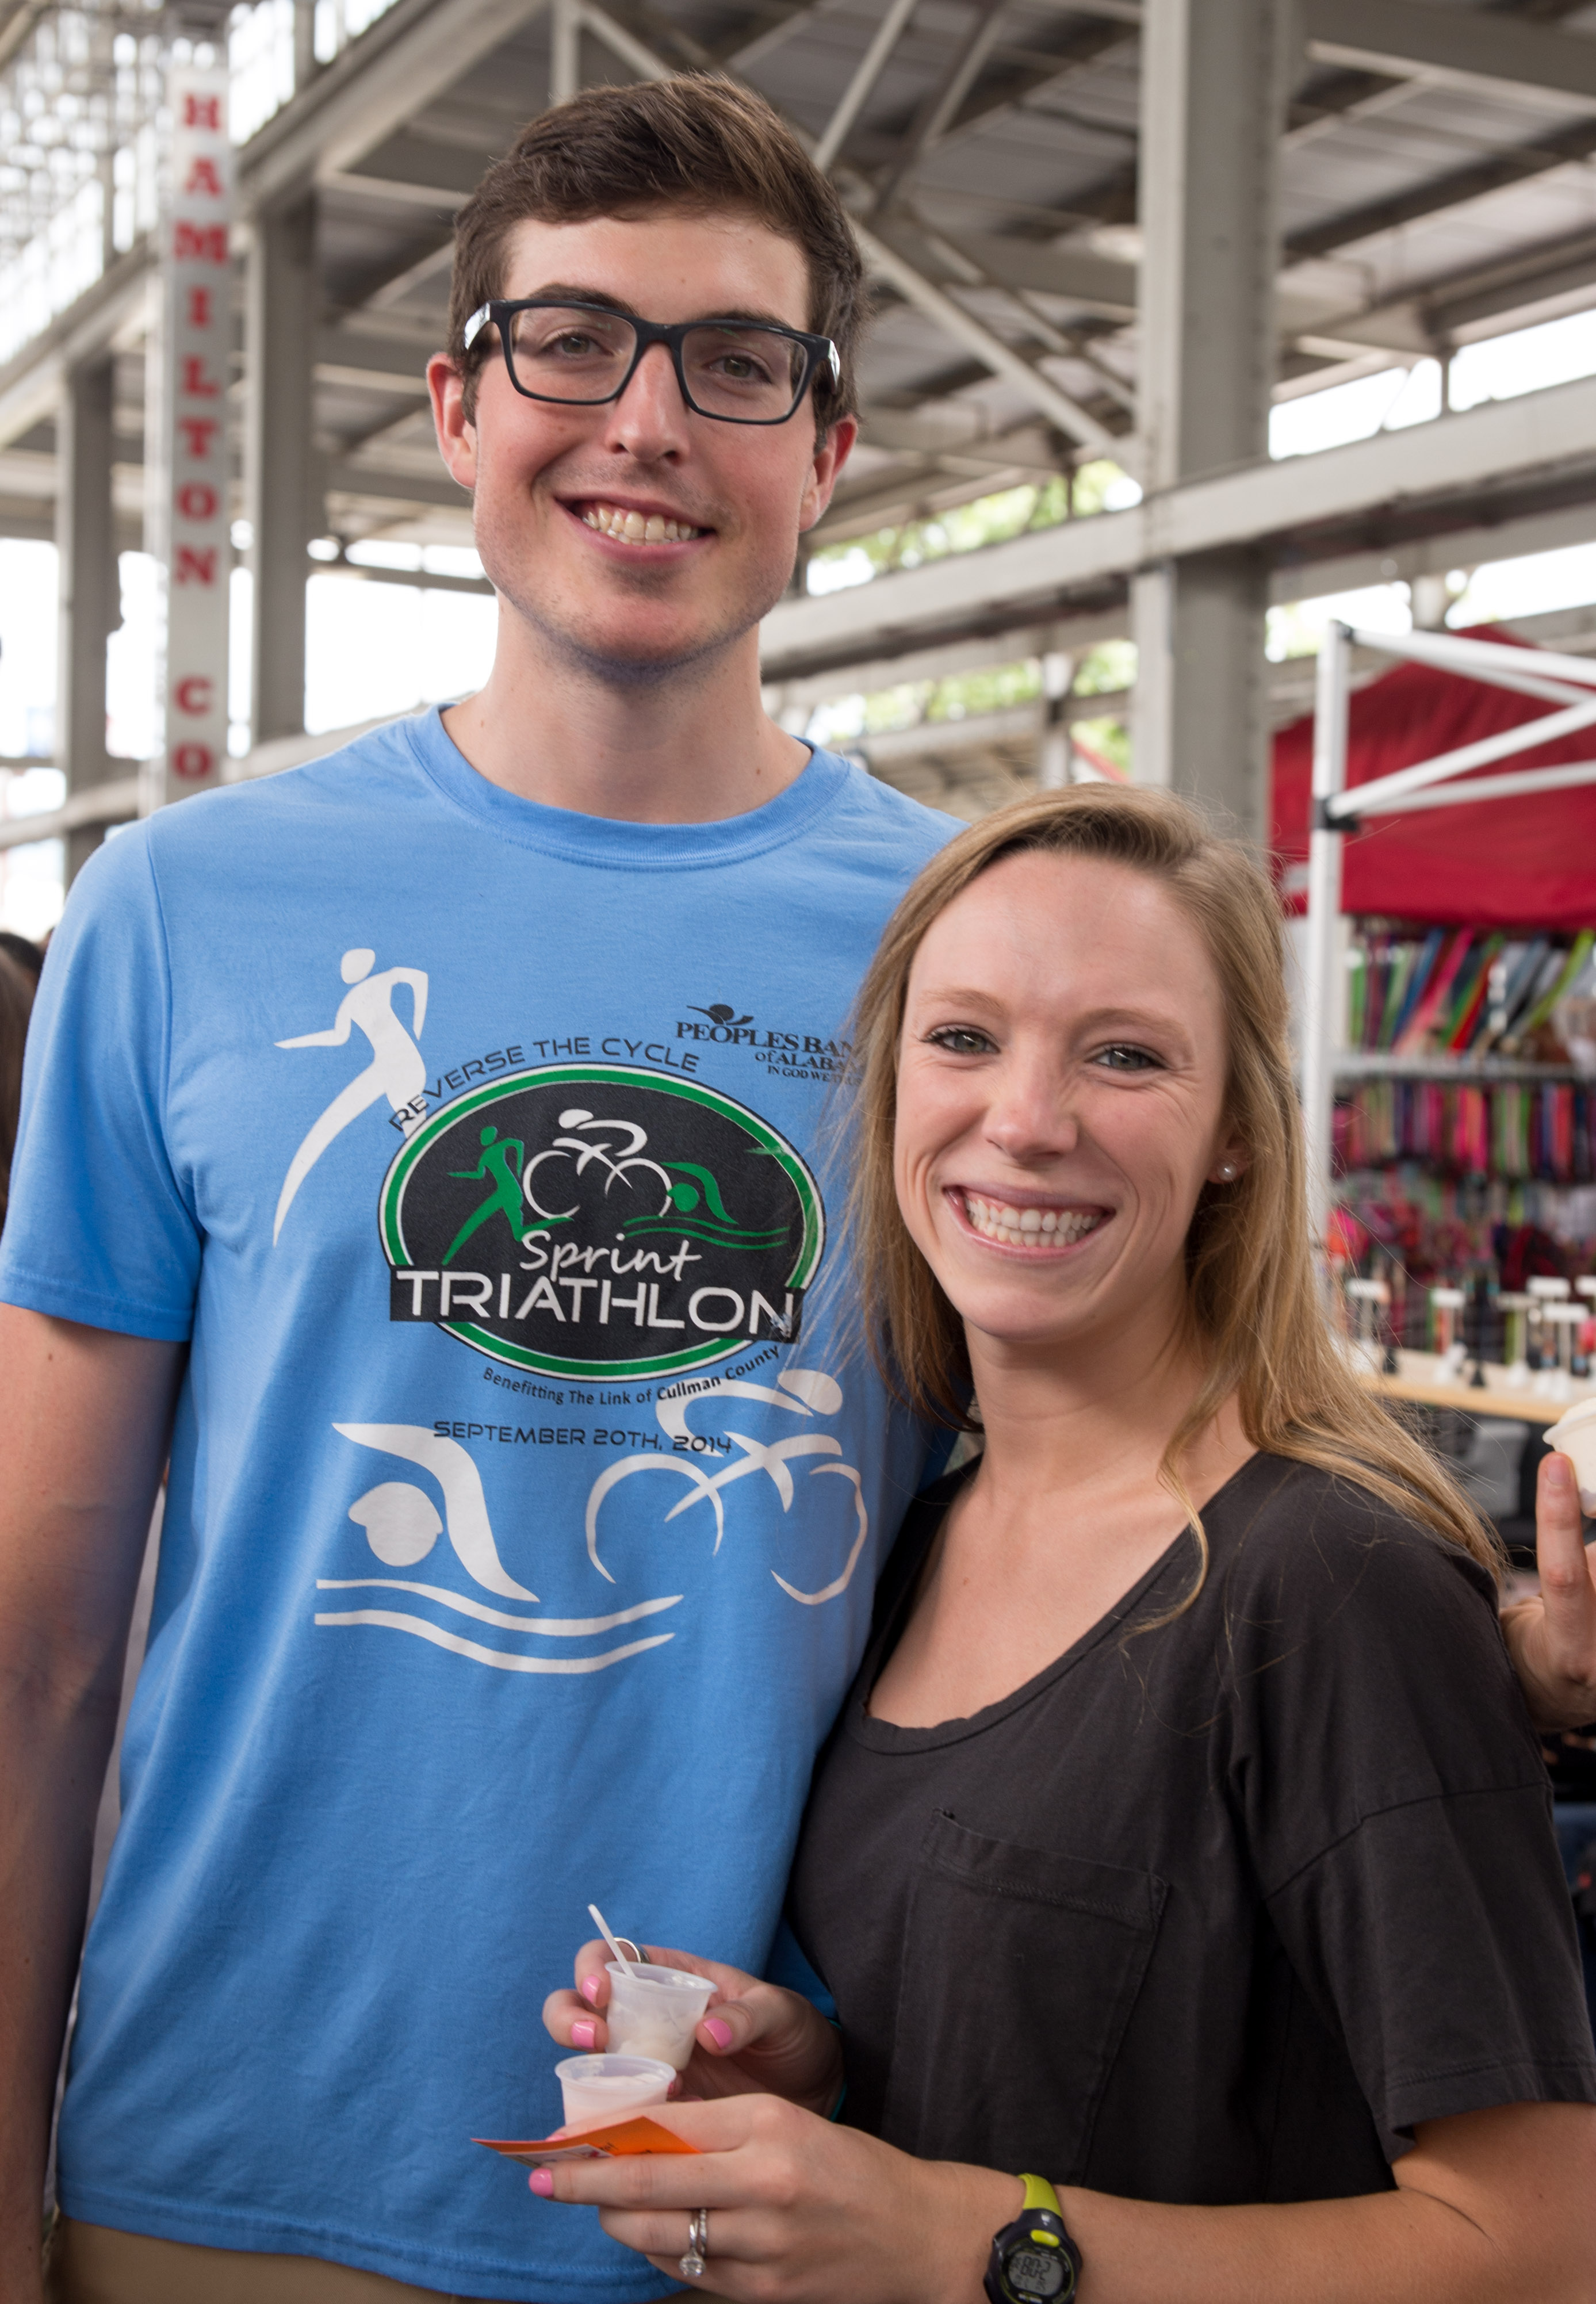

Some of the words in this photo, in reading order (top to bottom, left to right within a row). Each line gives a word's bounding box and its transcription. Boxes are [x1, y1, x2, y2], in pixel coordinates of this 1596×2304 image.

[174, 93, 228, 587] HAMILTON
[174, 675, 214, 782] CO
[676, 1021, 800, 1051] PEOPLES
[801, 1035, 853, 1058] BAN
[755, 1050, 777, 1064] of
[388, 1045, 526, 1132] REVERSE
[533, 1037, 591, 1058] THE
[602, 1038, 701, 1073] CYCLE
[767, 1065, 780, 1076] IN
[782, 1068, 809, 1080] GOD
[810, 1070, 830, 1082] WE
[519, 1229, 702, 1283] Sprint
[397, 1270, 794, 1338] TRIATHLON
[483, 1367, 565, 1406] Benefitting
[569, 1390, 595, 1405] The
[599, 1390, 631, 1406] Link
[636, 1388, 652, 1403] of
[657, 1375, 721, 1400] Cullman
[725, 1345, 780, 1380] County
[433, 1421, 586, 1445] SEPTEMBER
[593, 1428, 663, 1451] 20TH,
[672, 1435, 732, 1454] 2014
